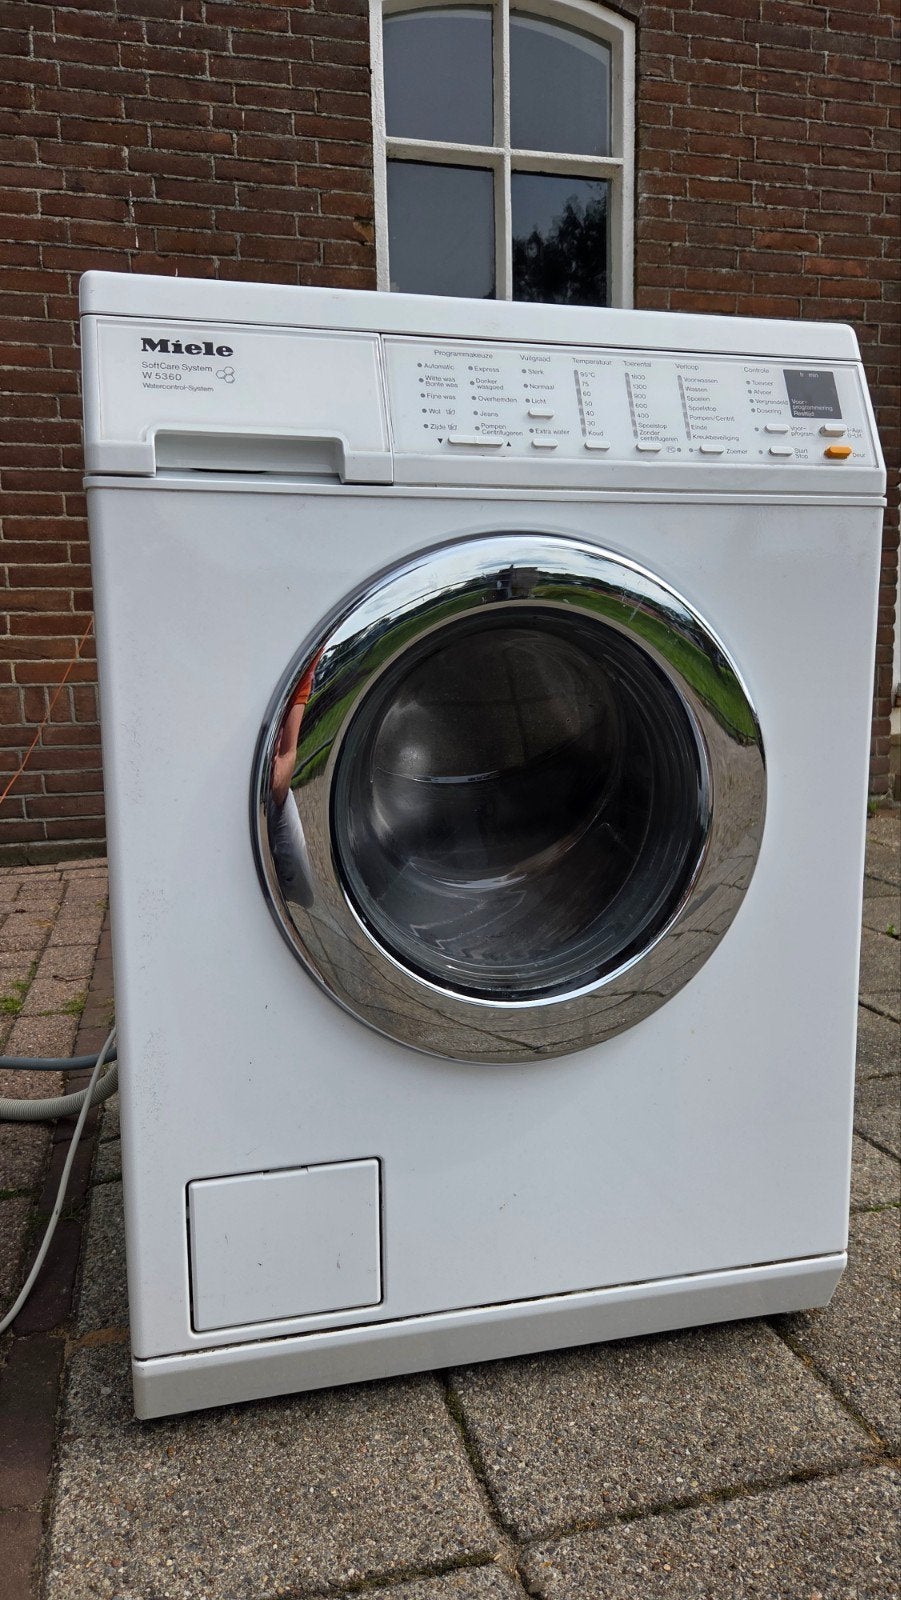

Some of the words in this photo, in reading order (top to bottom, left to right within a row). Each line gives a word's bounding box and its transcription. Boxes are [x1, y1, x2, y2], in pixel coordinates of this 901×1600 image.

[141, 337, 234, 357] Miele
[434, 350, 493, 360] Programmakeuze
[520, 354, 551, 363] Vulgraad
[424, 362, 454, 370] Automatic
[572, 357, 612, 366] Temperatuur
[623, 360, 652, 368] Toerental
[141, 361, 180, 371] SoftCare
[181, 363, 213, 373] System
[675, 363, 700, 371] Verloop
[142, 371, 152, 379] W
[155, 372, 182, 381] 5360
[142, 382, 214, 393] Watercontrol-System
[638, 422, 668, 430] Spoelstop
[481, 428, 524, 437] Centrifugeren
